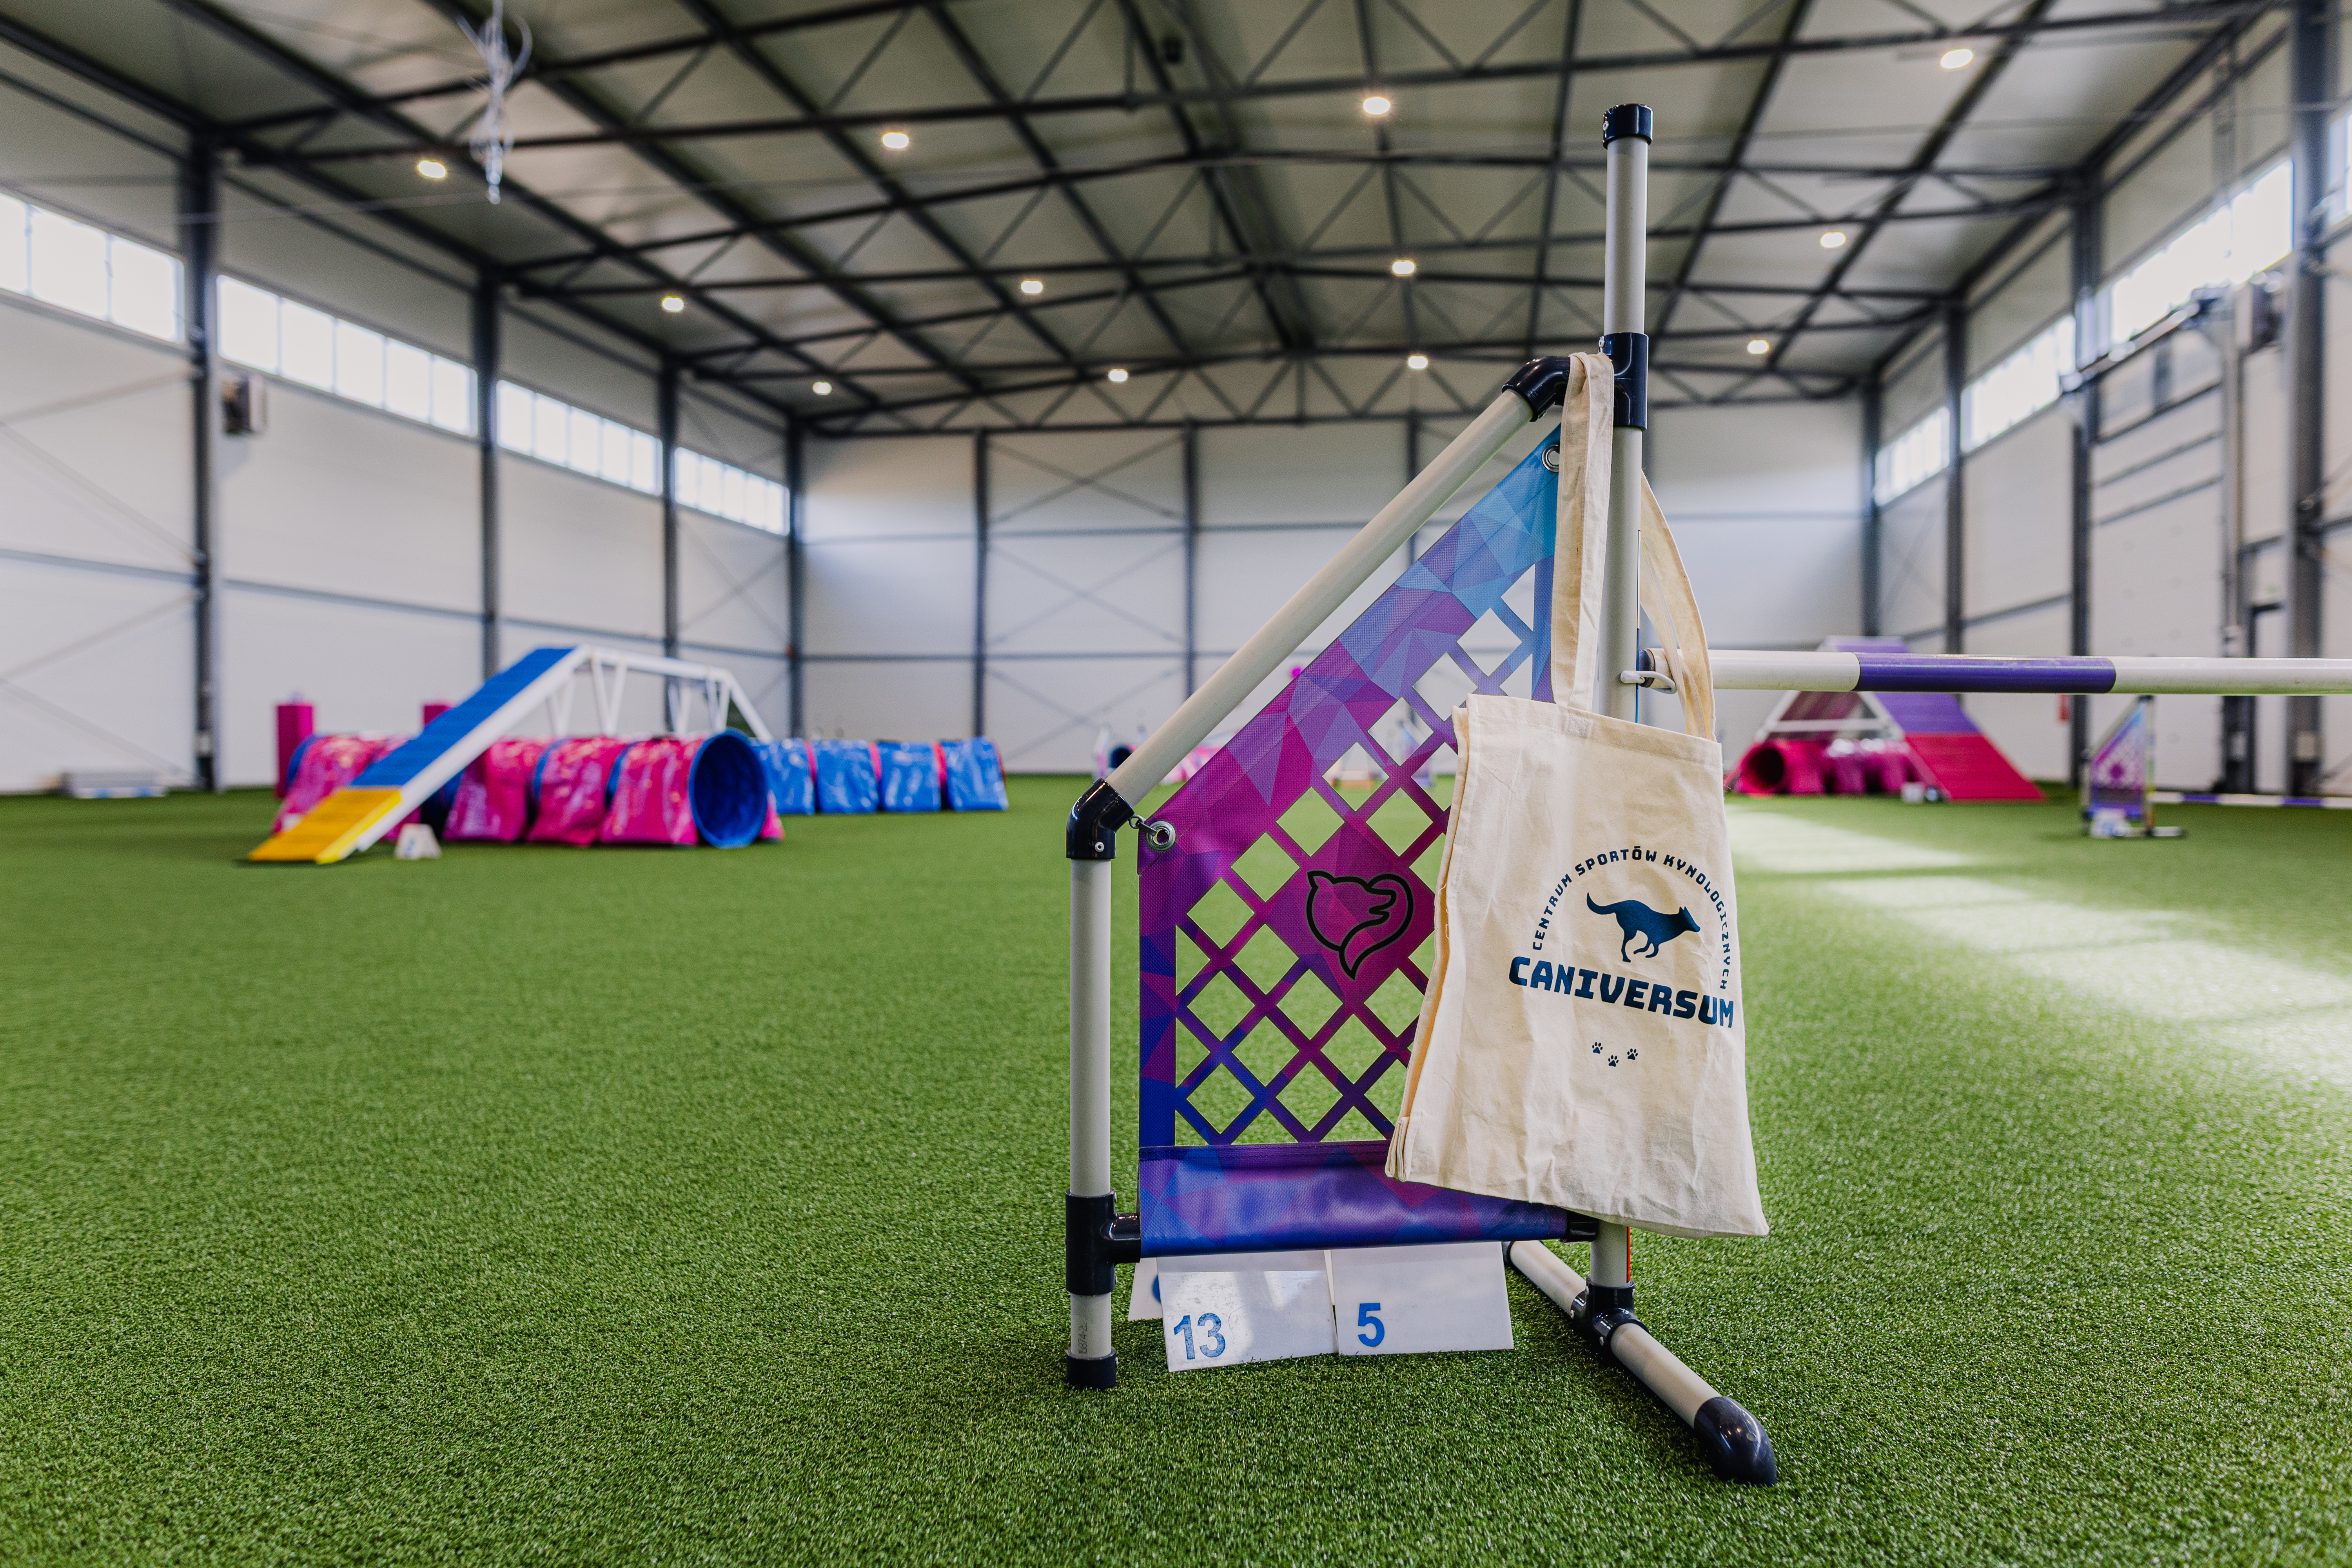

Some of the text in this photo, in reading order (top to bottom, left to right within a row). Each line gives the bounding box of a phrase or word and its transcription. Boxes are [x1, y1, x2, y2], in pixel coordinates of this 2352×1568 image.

[1532, 874, 1572, 951] CENTRUM
[1663, 854, 1730, 990] KYNOLOGICZNYCH
[1509, 956, 1734, 1028] CANIVERSUM
[1173, 1313, 1226, 1360] 13
[1357, 1302, 1385, 1347] 5
